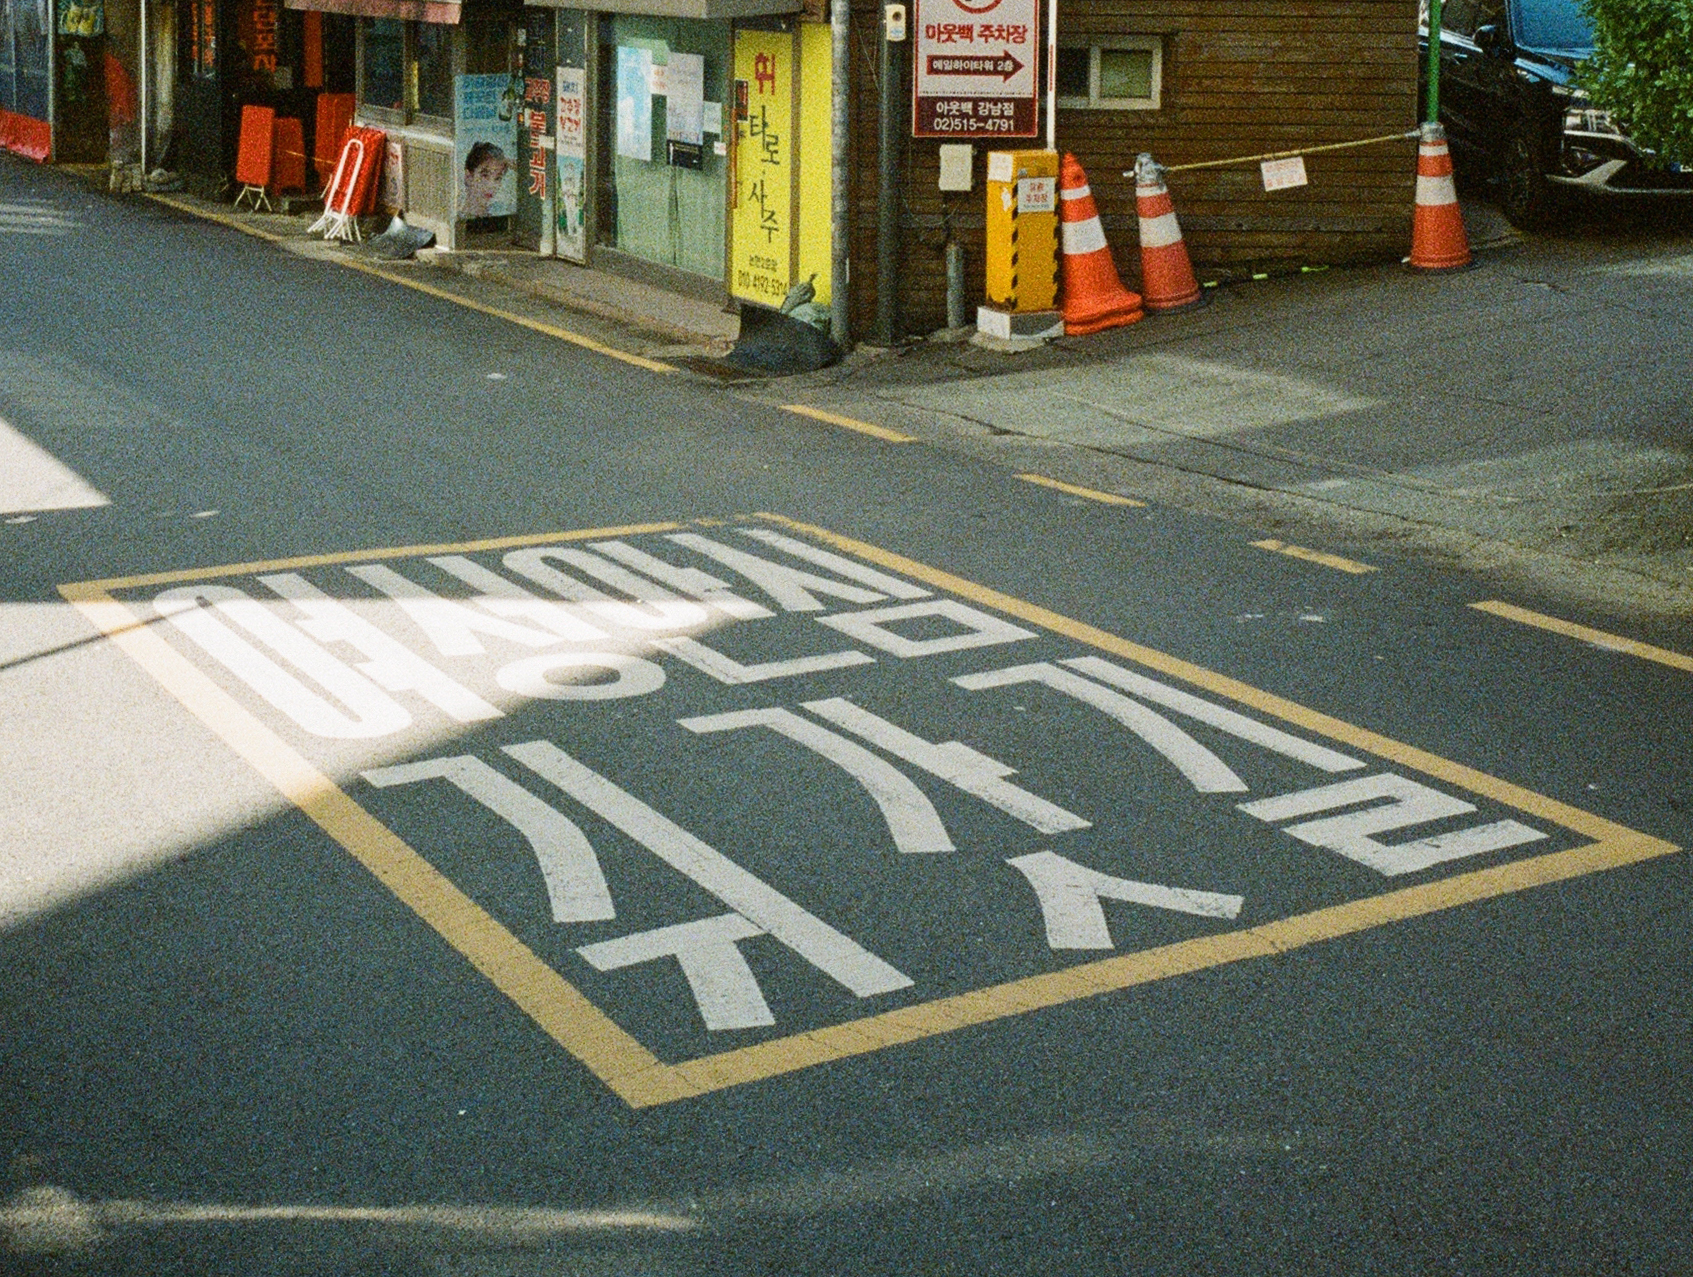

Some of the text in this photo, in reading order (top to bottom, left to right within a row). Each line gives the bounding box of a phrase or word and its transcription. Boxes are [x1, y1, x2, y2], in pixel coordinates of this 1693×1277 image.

[925, 23, 1028, 44] 아웃백 주차장
[936, 101, 1014, 116] 아웃백 강남점
[934, 118, 1014, 132] 02)515-4791
[153, 527, 1038, 739] 여성안심
[360, 658, 1548, 1032] 귀갓길
